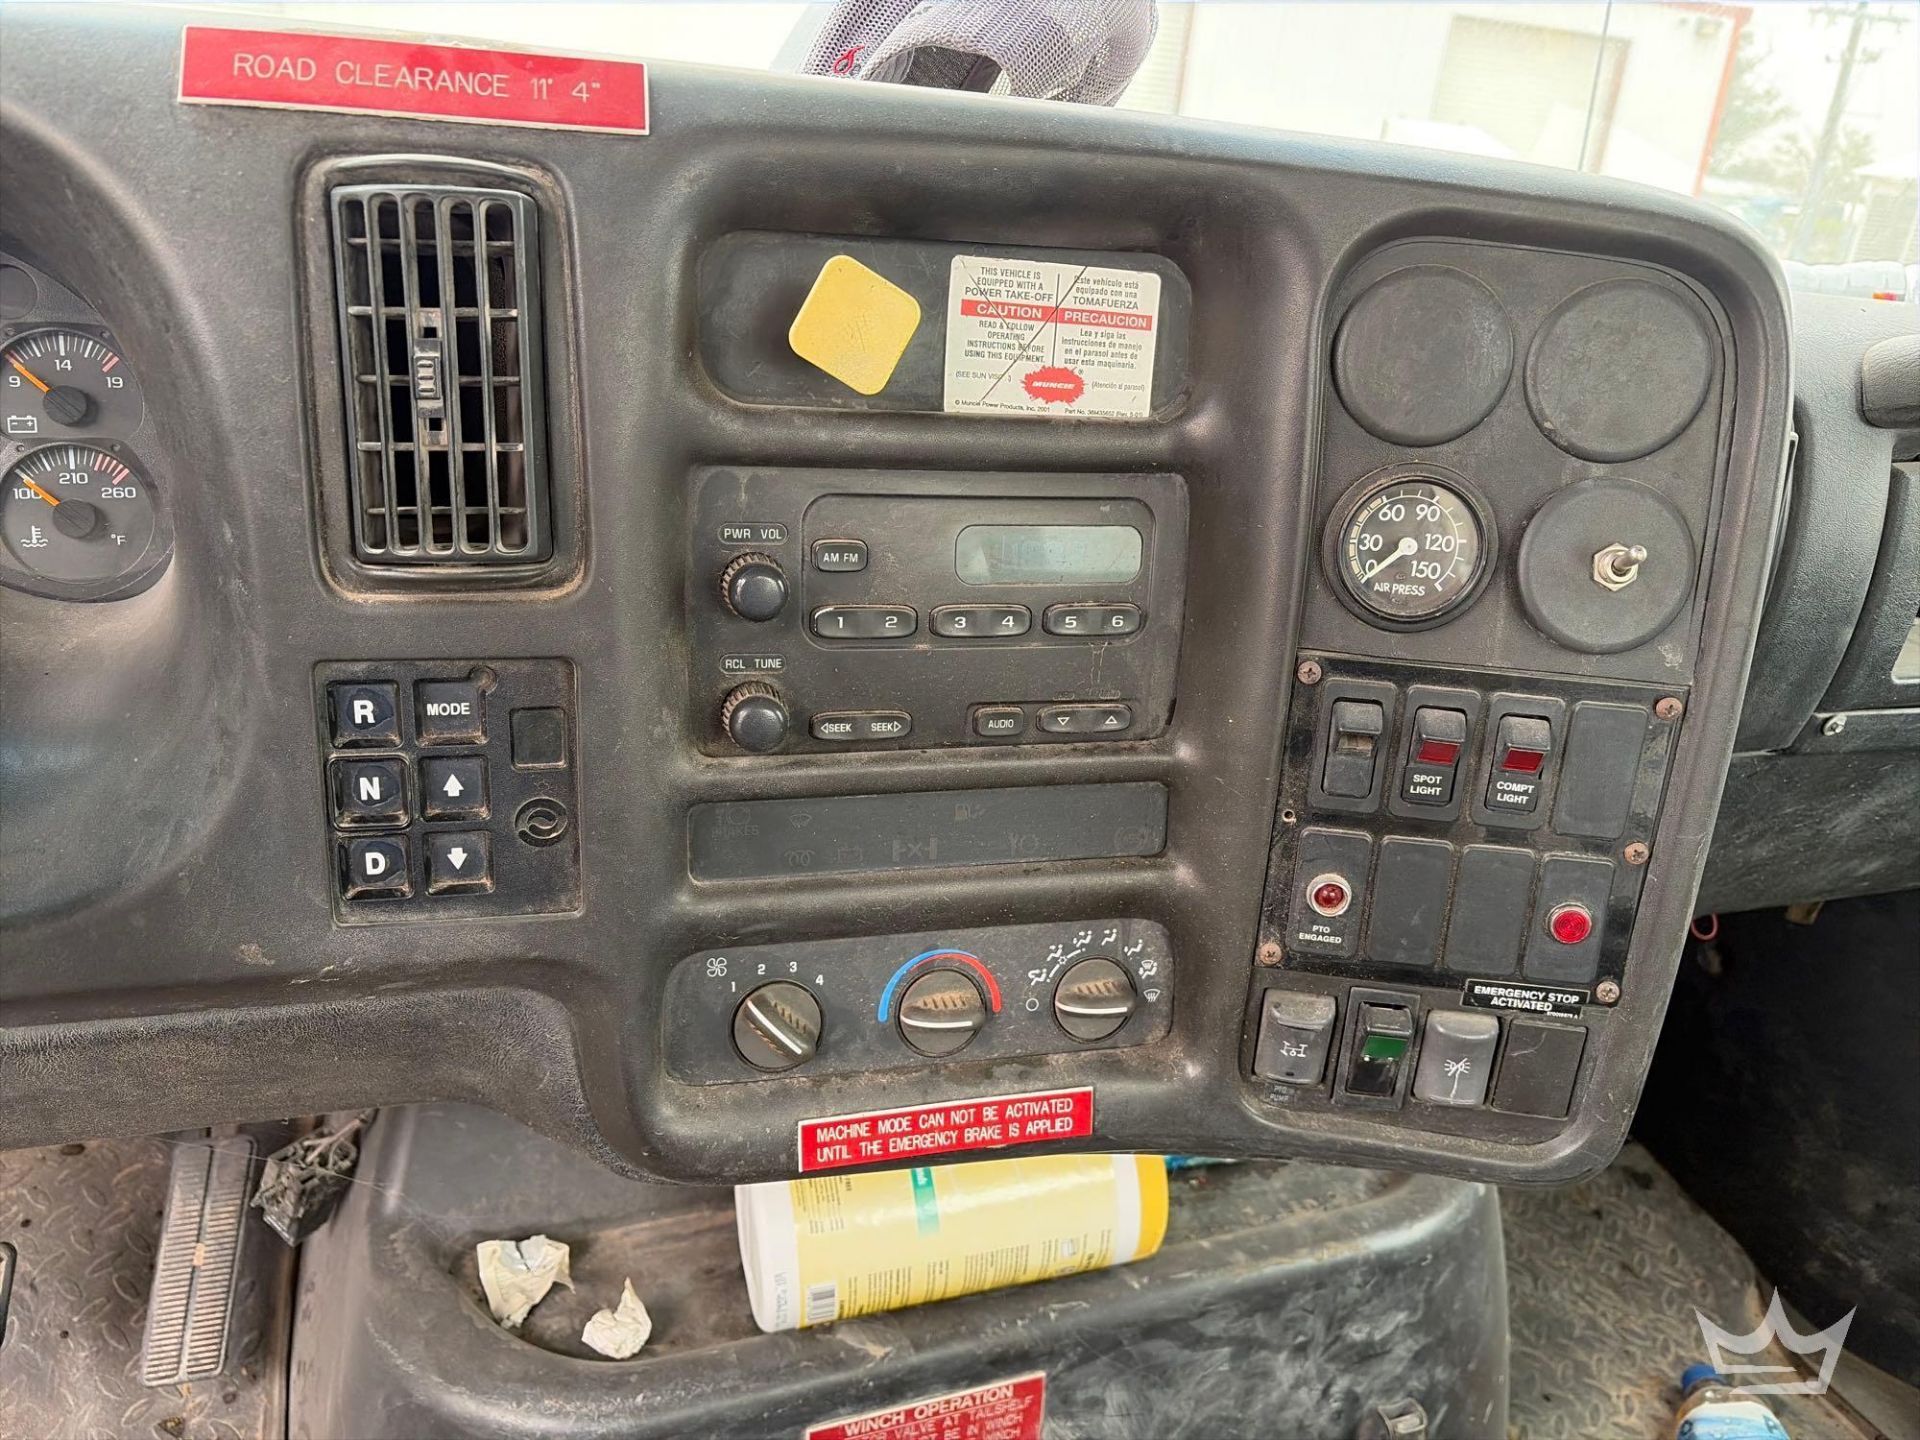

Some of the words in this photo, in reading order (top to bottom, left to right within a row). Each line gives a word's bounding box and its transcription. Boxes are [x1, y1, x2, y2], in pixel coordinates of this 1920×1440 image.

[232, 53, 317, 82] ROAD
[335, 60, 510, 98] CLEARANCE
[980, 266, 998, 276] THIS
[1000, 268, 1031, 279] VEHICLE
[1034, 271, 1041, 280] IS
[977, 277, 1014, 288] EQUIPPED
[1016, 281, 1036, 290] WITH
[1038, 283, 1044, 291] A
[1124, 280, 1139, 290] está
[964, 286, 1002, 298] POWER
[1004, 289, 1054, 302] TAKE-OFF
[1075, 286, 1108, 296] equipado
[1072, 296, 1139, 310] TOMAFUERZA
[976, 303, 1042, 318] CAUTION
[1064, 310, 1147, 328] PRECAUCION
[978, 320, 997, 329] READ
[987, 331, 1025, 341] OPERATING
[1079, 328, 1093, 337] Lea
[1100, 330, 1115, 339] siga
[1116, 332, 1127, 340] las
[967, 339, 1016, 351] INSTRUCTIONS
[1018, 342, 1045, 353] BEFORE
[1118, 342, 1142, 352] manejo
[964, 349, 985, 359] USING
[987, 351, 1002, 360] THIS
[1083, 349, 1109, 358] parasol
[1110, 351, 1128, 359] antes
[1130, 352, 1138, 360] de
[54, 360, 73, 371] 14
[1080, 358, 1095, 366] esta
[972, 371, 987, 379] SUN
[8, 376, 21, 388] 9
[106, 376, 124, 388] 19
[1031, 380, 1077, 390] MUNCIE
[59, 472, 89, 484] 210
[12, 488, 42, 500] 100
[101, 487, 137, 499] 260
[1378, 504, 1405, 522] 60
[1415, 504, 1441, 522] 90
[723, 528, 751, 539] PWR
[760, 528, 782, 540] VOL
[1359, 534, 1383, 551] 30
[1424, 533, 1455, 552] 120
[823, 553, 840, 563] AM
[843, 553, 858, 563] FM
[1365, 560, 1378, 577] 0
[1410, 560, 1441, 580] 150
[1373, 582, 1391, 593] AIR
[1391, 583, 1426, 597] PRESS
[837, 616, 844, 628] 1
[885, 616, 898, 628] 2
[954, 616, 966, 628] 3
[1001, 615, 1014, 627] 4
[1064, 616, 1077, 628] 5
[1111, 615, 1124, 628] 6
[725, 659, 746, 669] RCL
[755, 659, 782, 669] TUNE
[353, 699, 375, 724] R
[426, 703, 471, 716] MODE
[828, 723, 853, 733] SEEK
[871, 722, 893, 732] SEEK
[988, 719, 1014, 728] AUDIO
[1413, 774, 1443, 785] SPOT
[359, 777, 381, 801] N
[1410, 785, 1443, 797] LIGHT
[1496, 781, 1535, 794] COMPT
[1497, 792, 1530, 805] LIGHT
[365, 851, 386, 876] D
[1312, 925, 1331, 934] PTO
[1298, 932, 1342, 944] ENGAGED
[758, 965, 766, 976] 2
[789, 962, 797, 972] 3
[815, 974, 824, 986] 4
[731, 982, 737, 992] 1
[1474, 985, 1546, 1000] EMERGENCY
[1548, 992, 1580, 1004] STOP
[1490, 997, 1553, 1012] ACTIVATED
[816, 1121, 871, 1143] MACHINE
[878, 1116, 911, 1135] MODE
[919, 1112, 945, 1129] CAN
[951, 1108, 975, 1126] NOT
[983, 1105, 998, 1121] BE
[1005, 1097, 1073, 1119] ACTIVATED
[816, 1144, 851, 1163] UNTIL
[859, 1140, 883, 1157] THE
[889, 1129, 958, 1152] EMERGENCY
[964, 1125, 1002, 1143] BRAKE
[1008, 1121, 1019, 1137] IS
[1025, 1117, 1073, 1135] APPLIED
[844, 1410, 905, 1437] WINCH
[913, 1384, 1014, 1420] OPERATION
[894, 1419, 936, 1439] VALVE
[943, 1413, 960, 1428] AT
[985, 1411, 1023, 1430] WINCH
